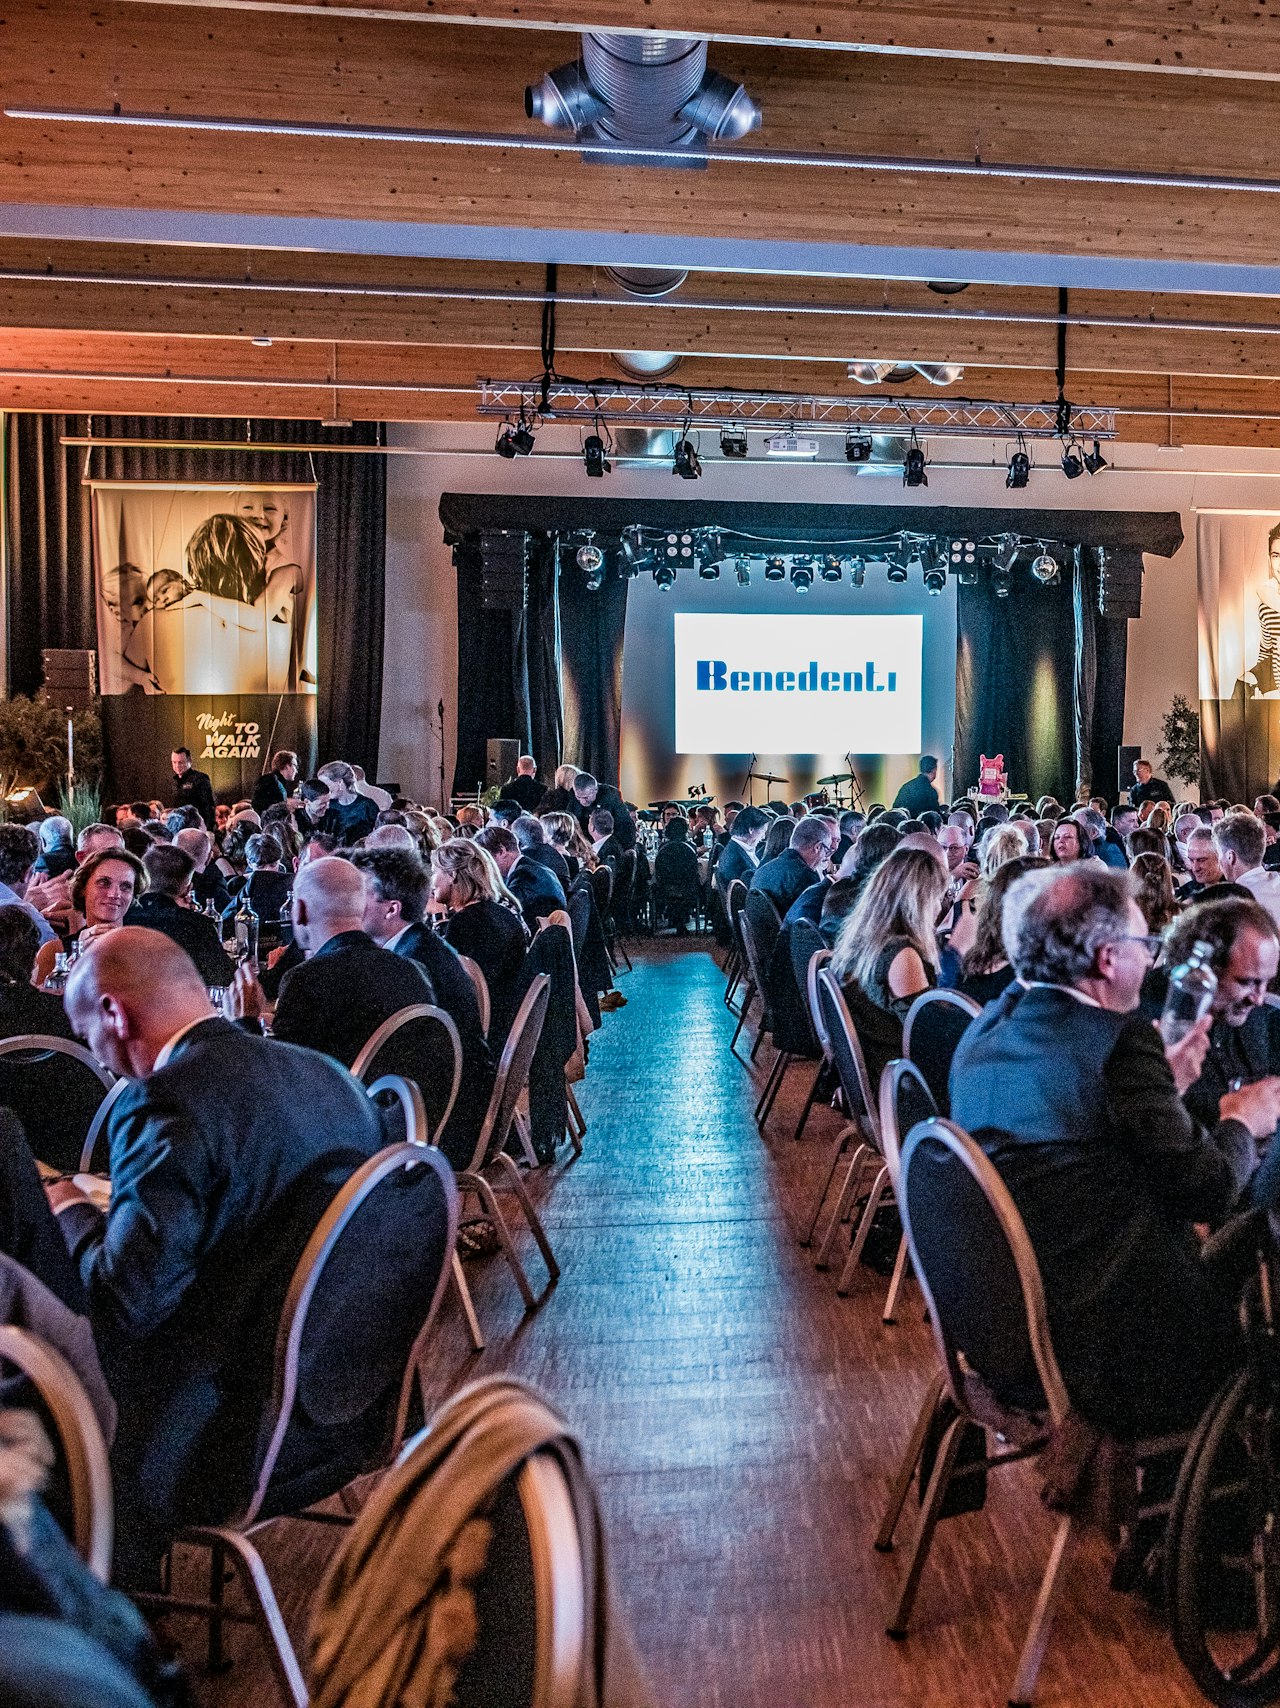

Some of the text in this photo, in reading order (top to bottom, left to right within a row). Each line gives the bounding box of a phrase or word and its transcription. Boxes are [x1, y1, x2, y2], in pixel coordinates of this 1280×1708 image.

[697, 660, 897, 691] Benedenti
[196, 711, 259, 734] Night TO
[206, 734, 261, 746] WALK
[200, 746, 260, 759] AGAIN
